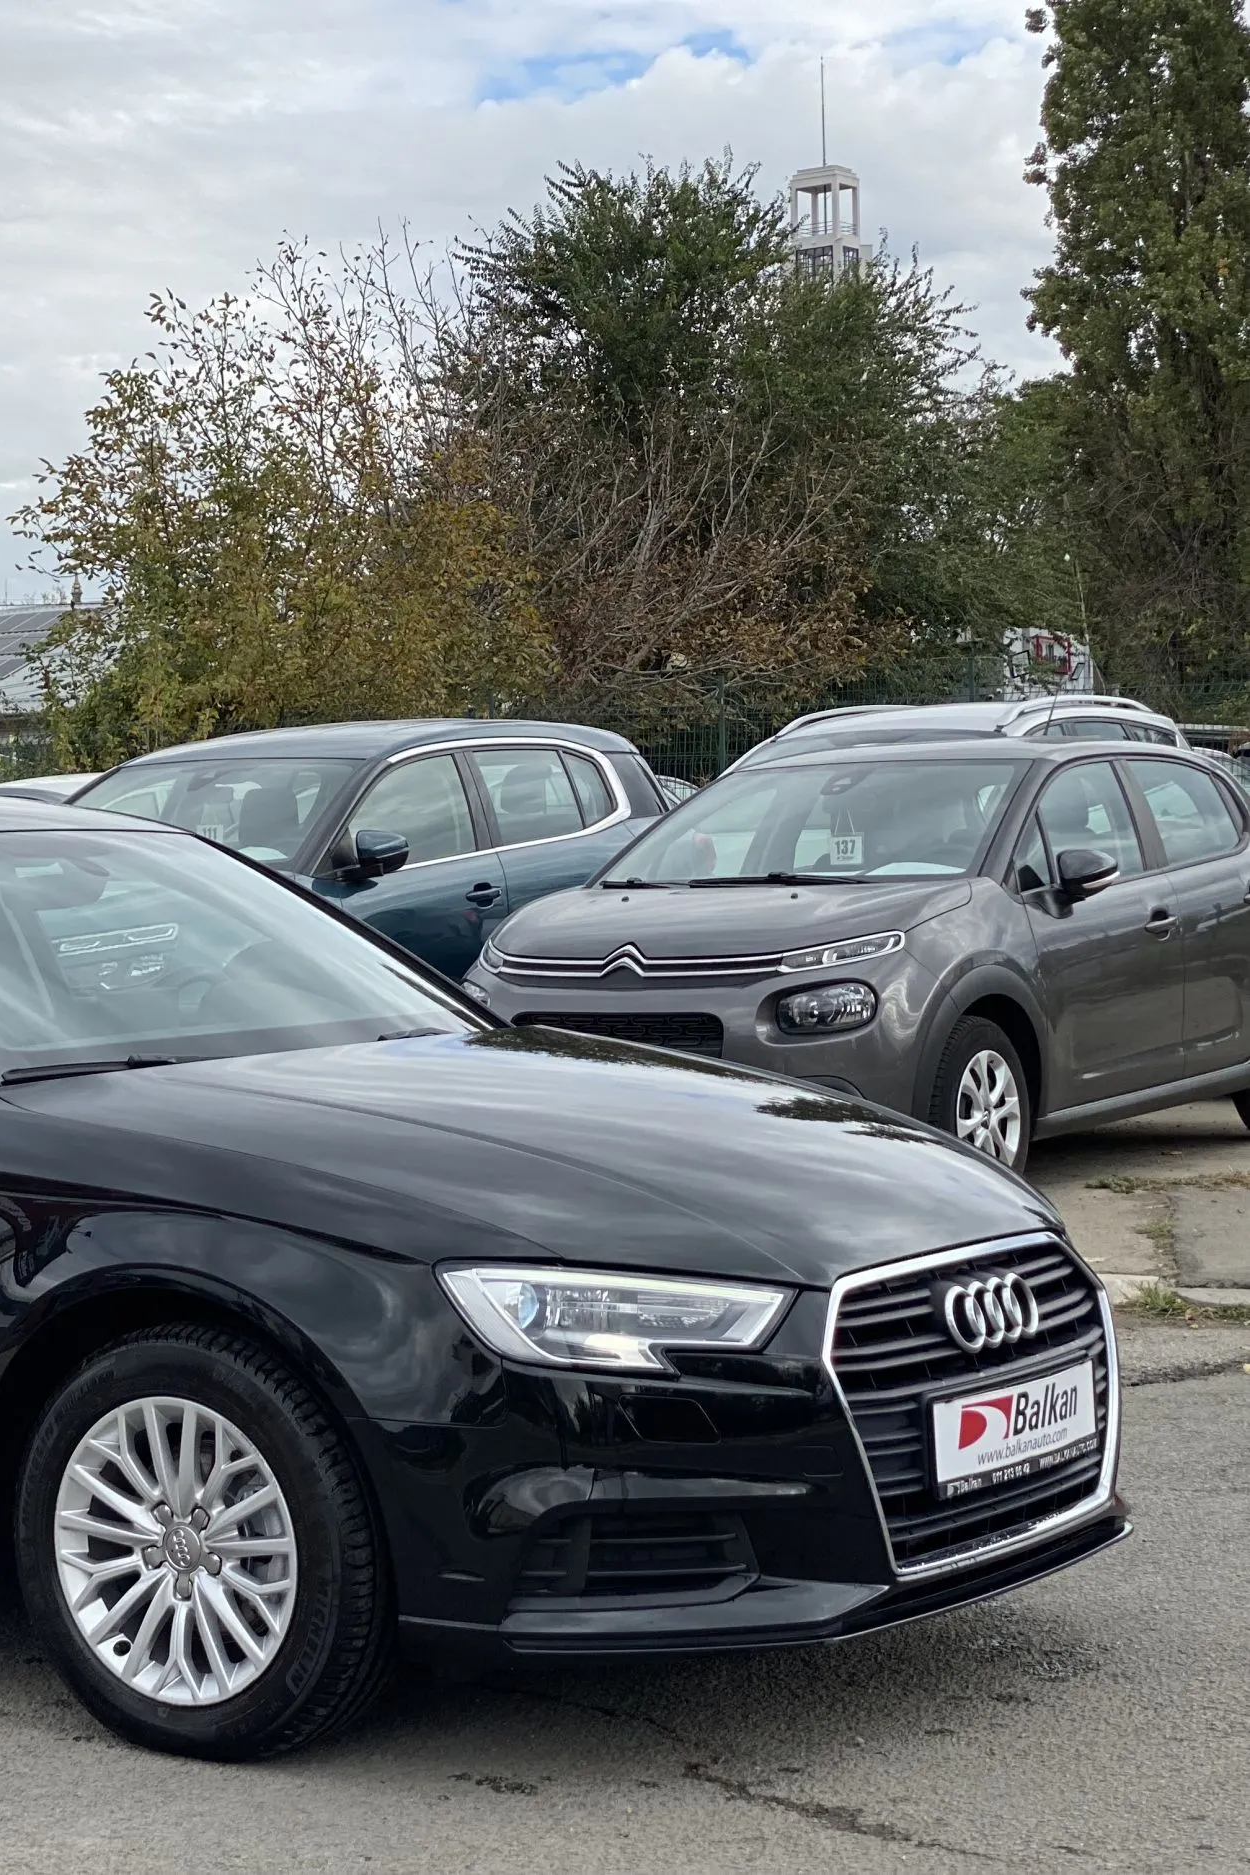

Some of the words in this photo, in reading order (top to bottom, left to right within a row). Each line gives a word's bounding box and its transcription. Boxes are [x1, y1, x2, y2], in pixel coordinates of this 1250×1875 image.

[834, 839, 856, 855] 137
[1012, 1382, 1078, 1436] Balkan
[978, 1427, 1068, 1465] www.balkanauto.com
